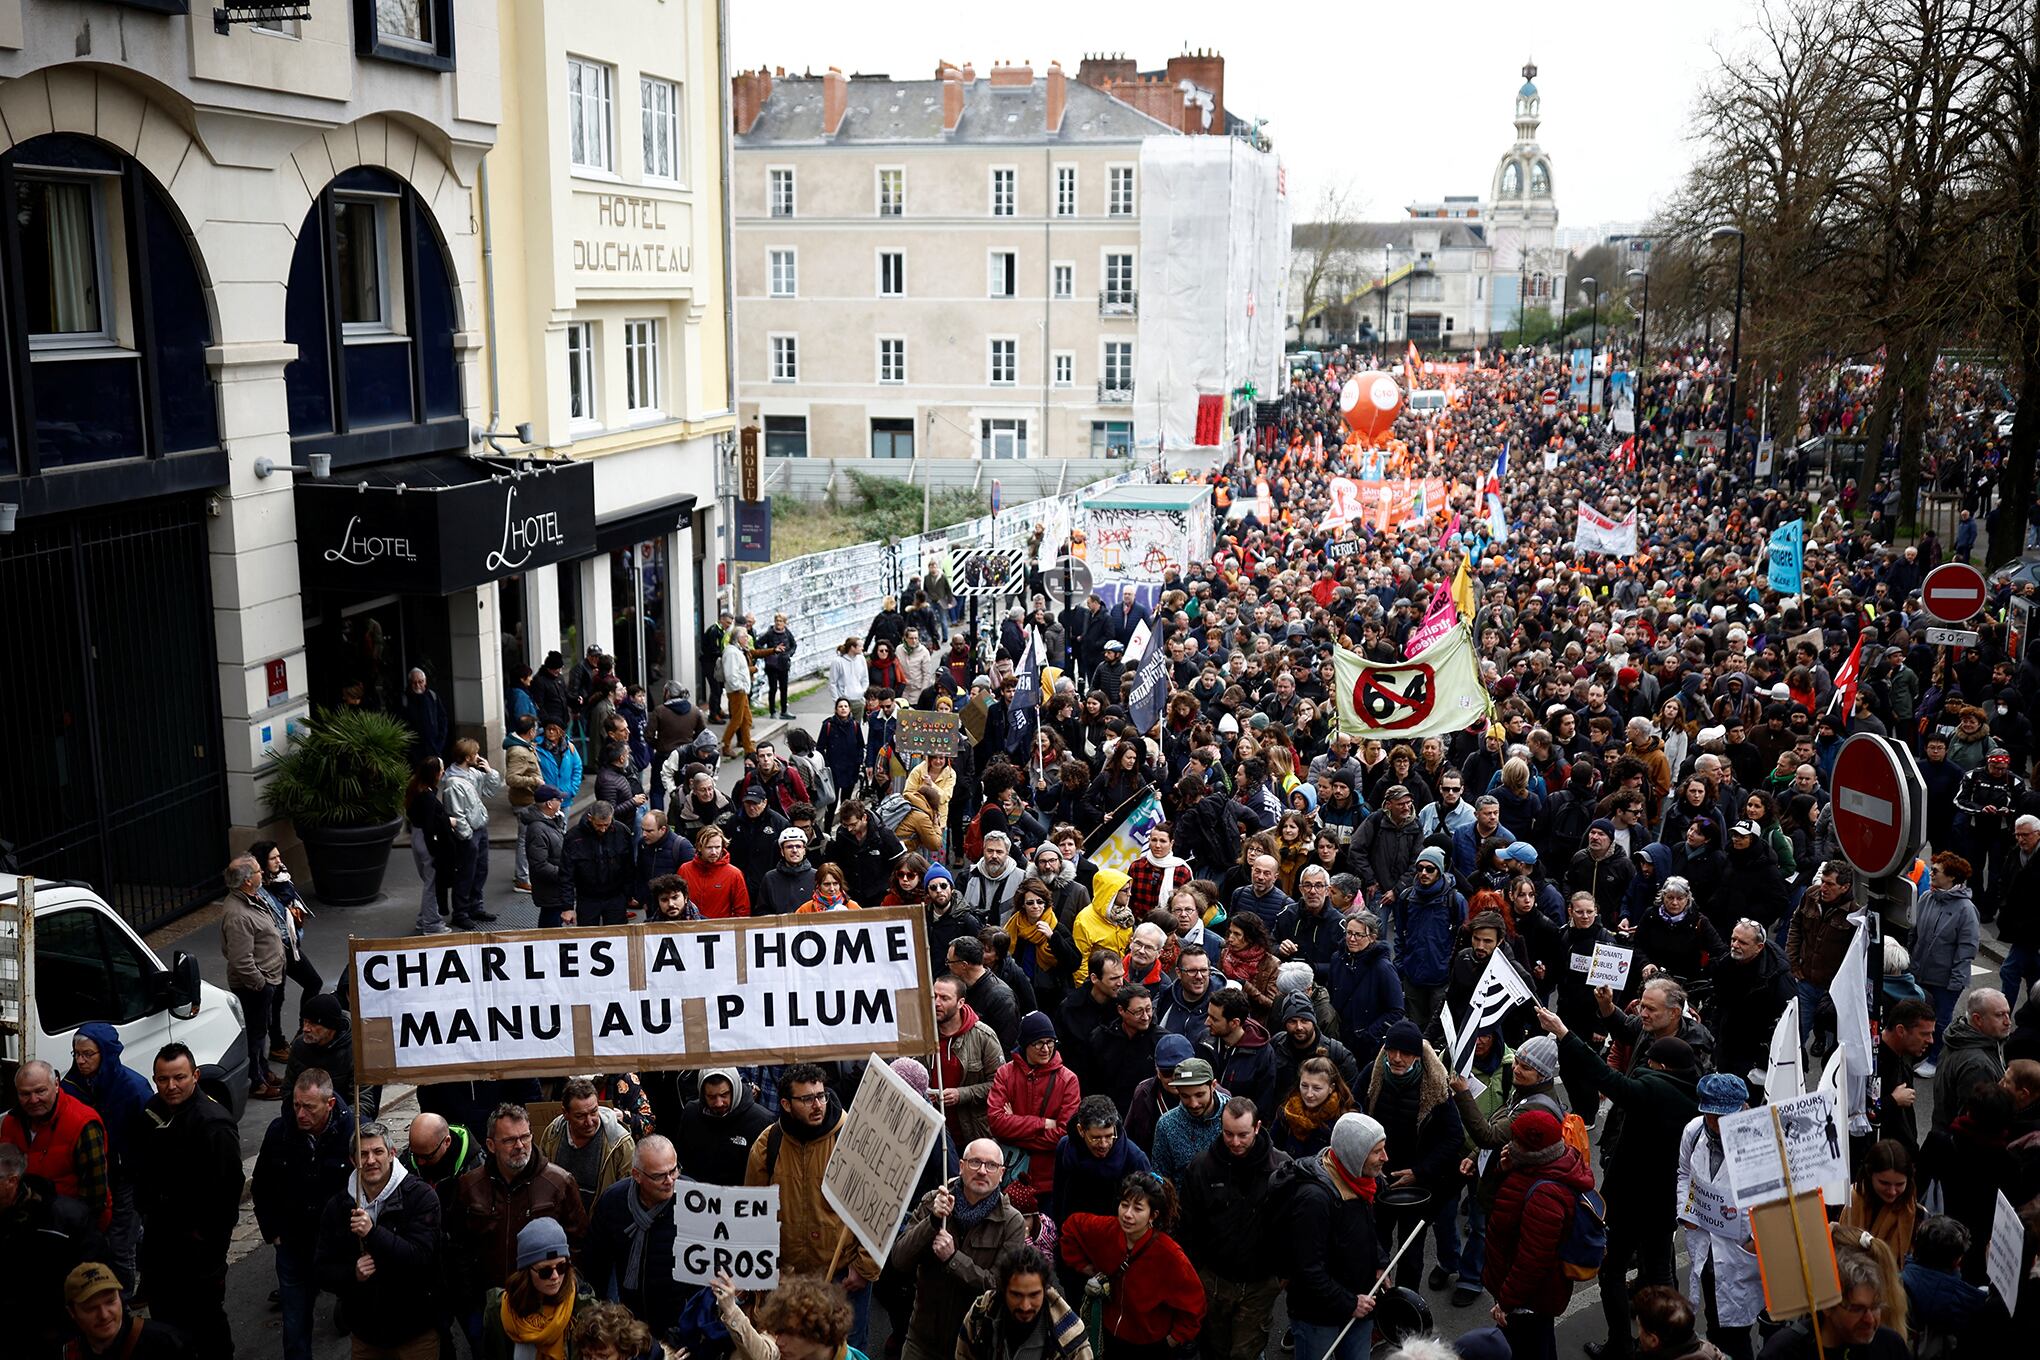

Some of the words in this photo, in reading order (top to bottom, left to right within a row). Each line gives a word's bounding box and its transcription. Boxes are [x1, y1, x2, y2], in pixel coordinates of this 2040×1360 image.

[744, 445, 756, 500] HOTEL
[275, 663, 284, 679] H
[1362, 673, 1427, 720] 64
[363, 940, 615, 991] CHARLES
[651, 934, 721, 973] AT
[754, 926, 909, 969] HOME
[400, 1004, 562, 1049] MANU
[598, 998, 672, 1037] AU
[716, 988, 895, 1030] PILUM
[1797, 1095, 1823, 1110] JOURS
[851, 1122, 891, 1177] GUEULE
[884, 1153, 915, 1202] ELLE
[734, 1200, 768, 1218] EN
[713, 1221, 730, 1240] A
[683, 1244, 774, 1280] GROS
